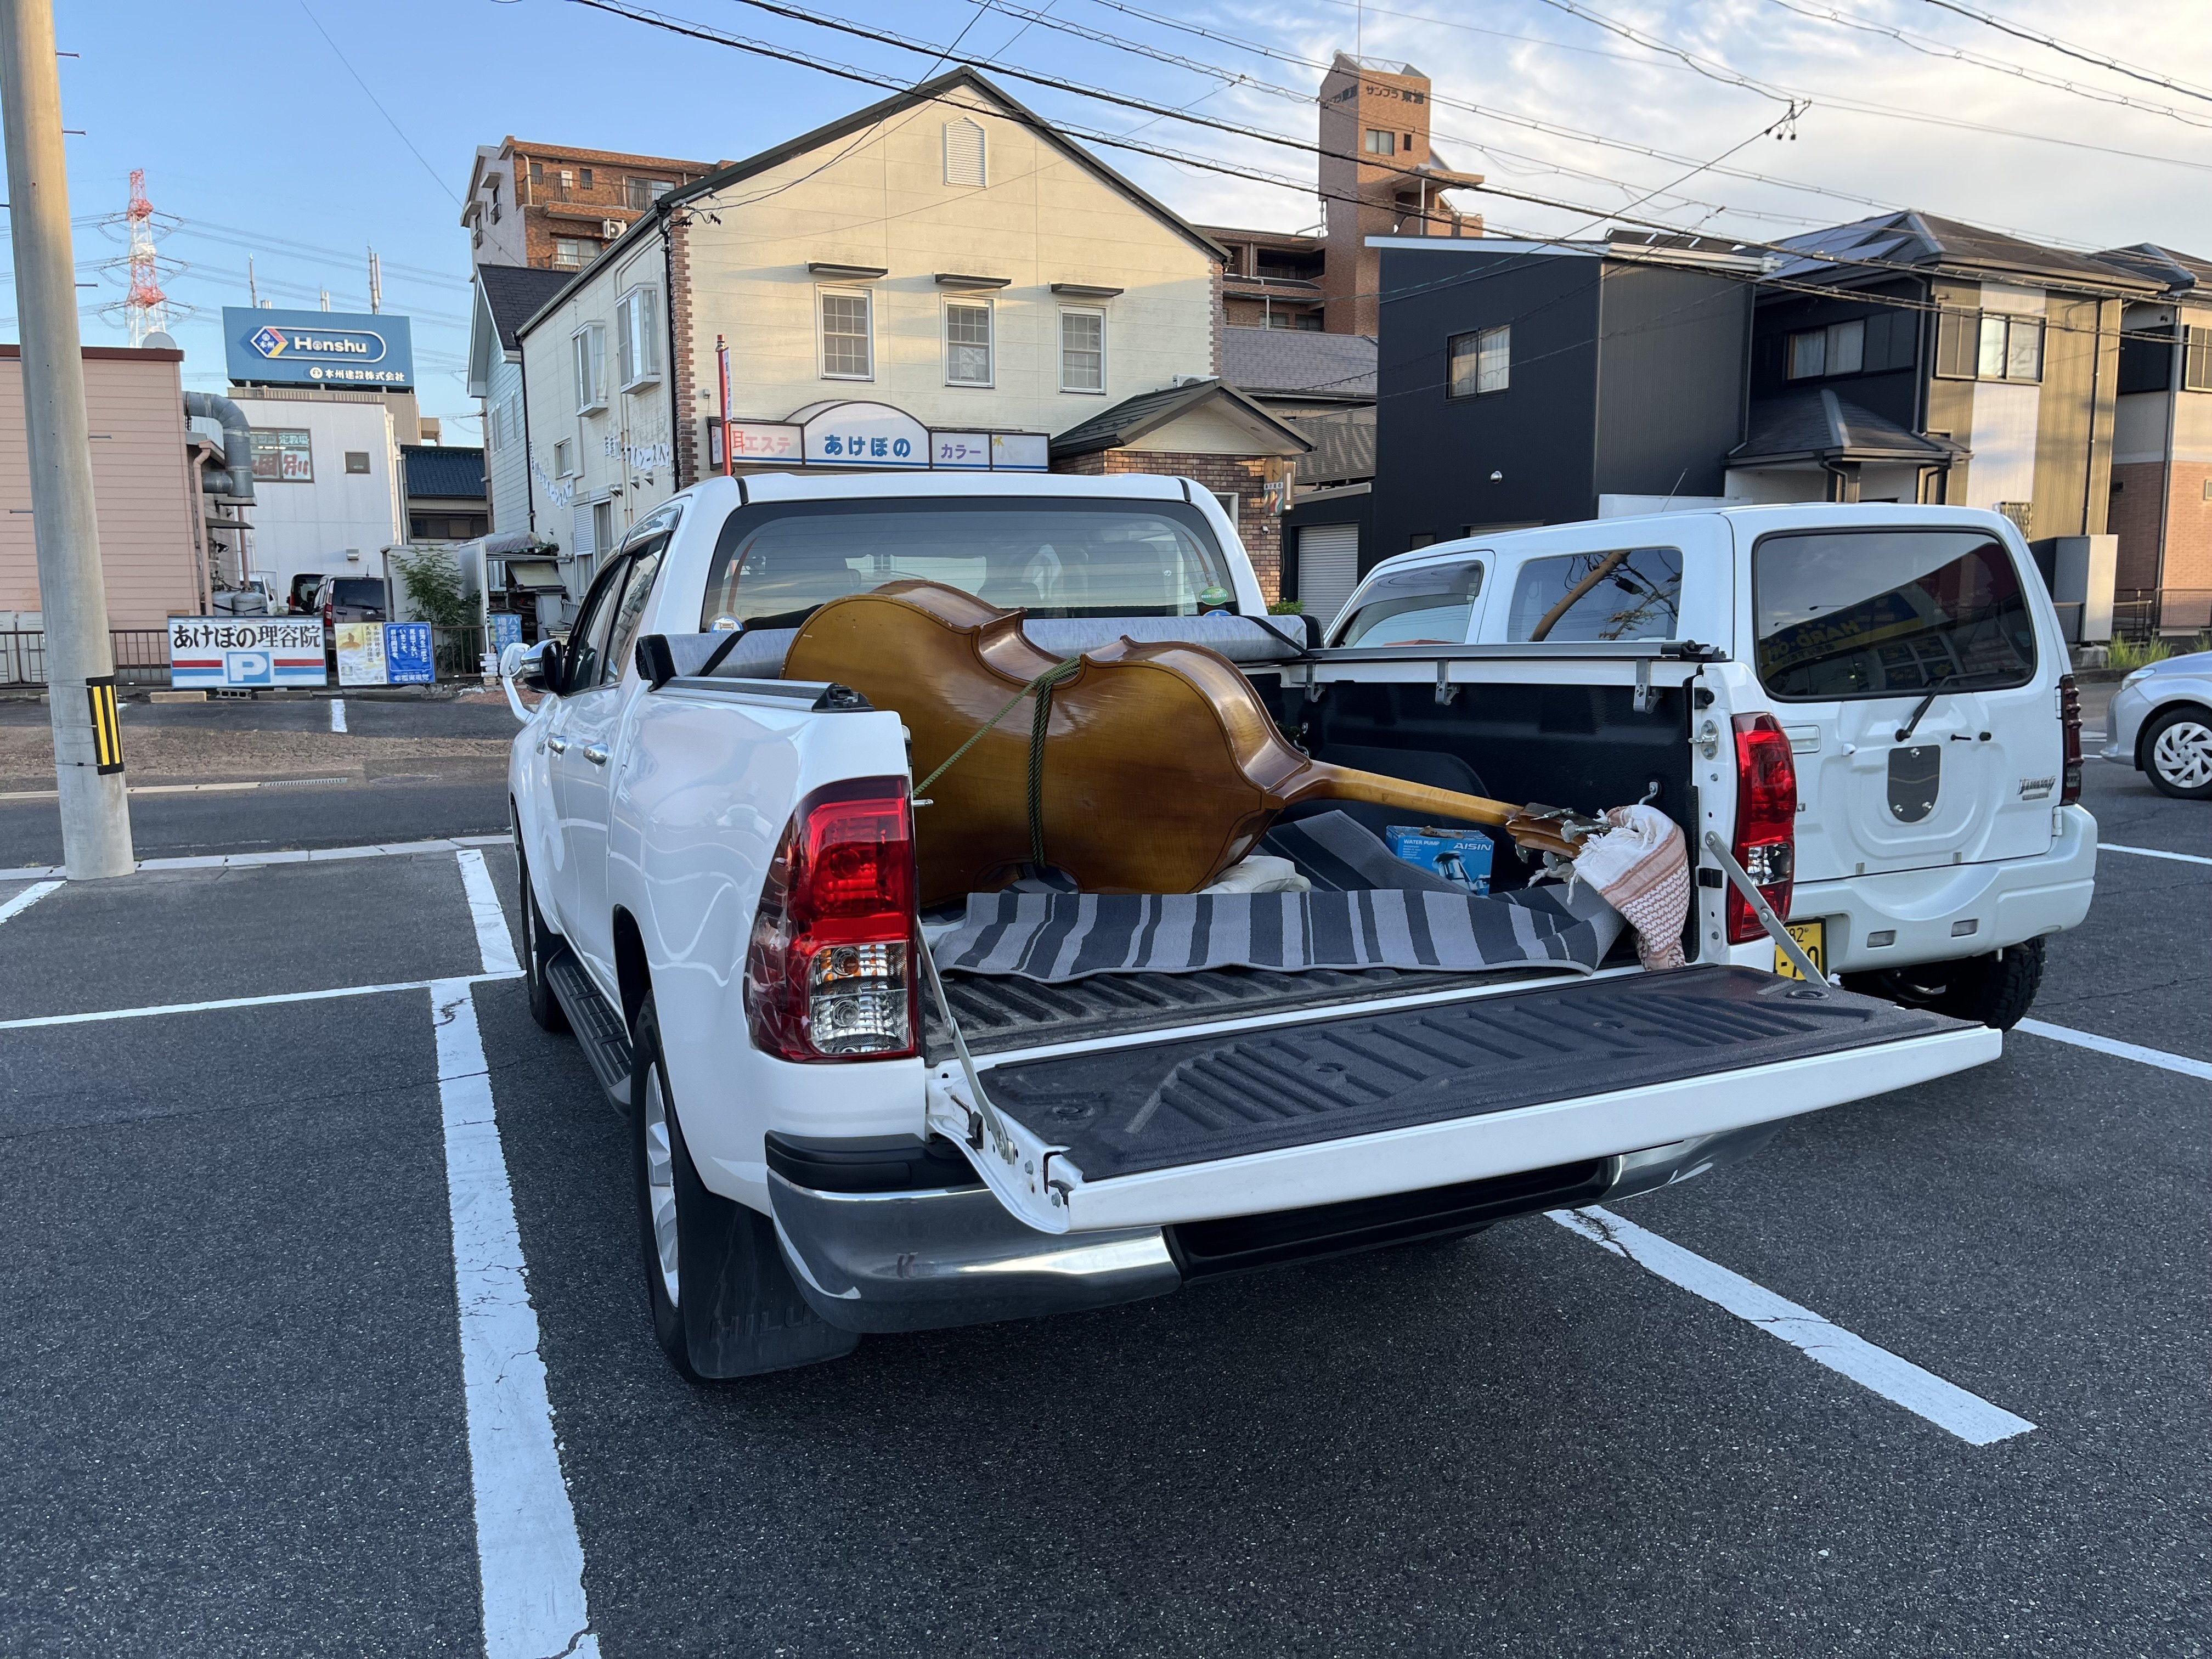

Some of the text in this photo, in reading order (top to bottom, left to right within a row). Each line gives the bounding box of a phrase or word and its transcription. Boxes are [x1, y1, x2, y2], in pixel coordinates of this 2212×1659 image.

[325, 369, 405, 382] 本州建設株式会社
[825, 435, 911, 458] あけぼの
[941, 443, 982, 459] カラー
[173, 624, 321, 649] あけぼの理容院
[230, 654, 268, 682] P
[1453, 842, 1492, 851] AISIN
[708, 1304, 823, 1342] HILU
